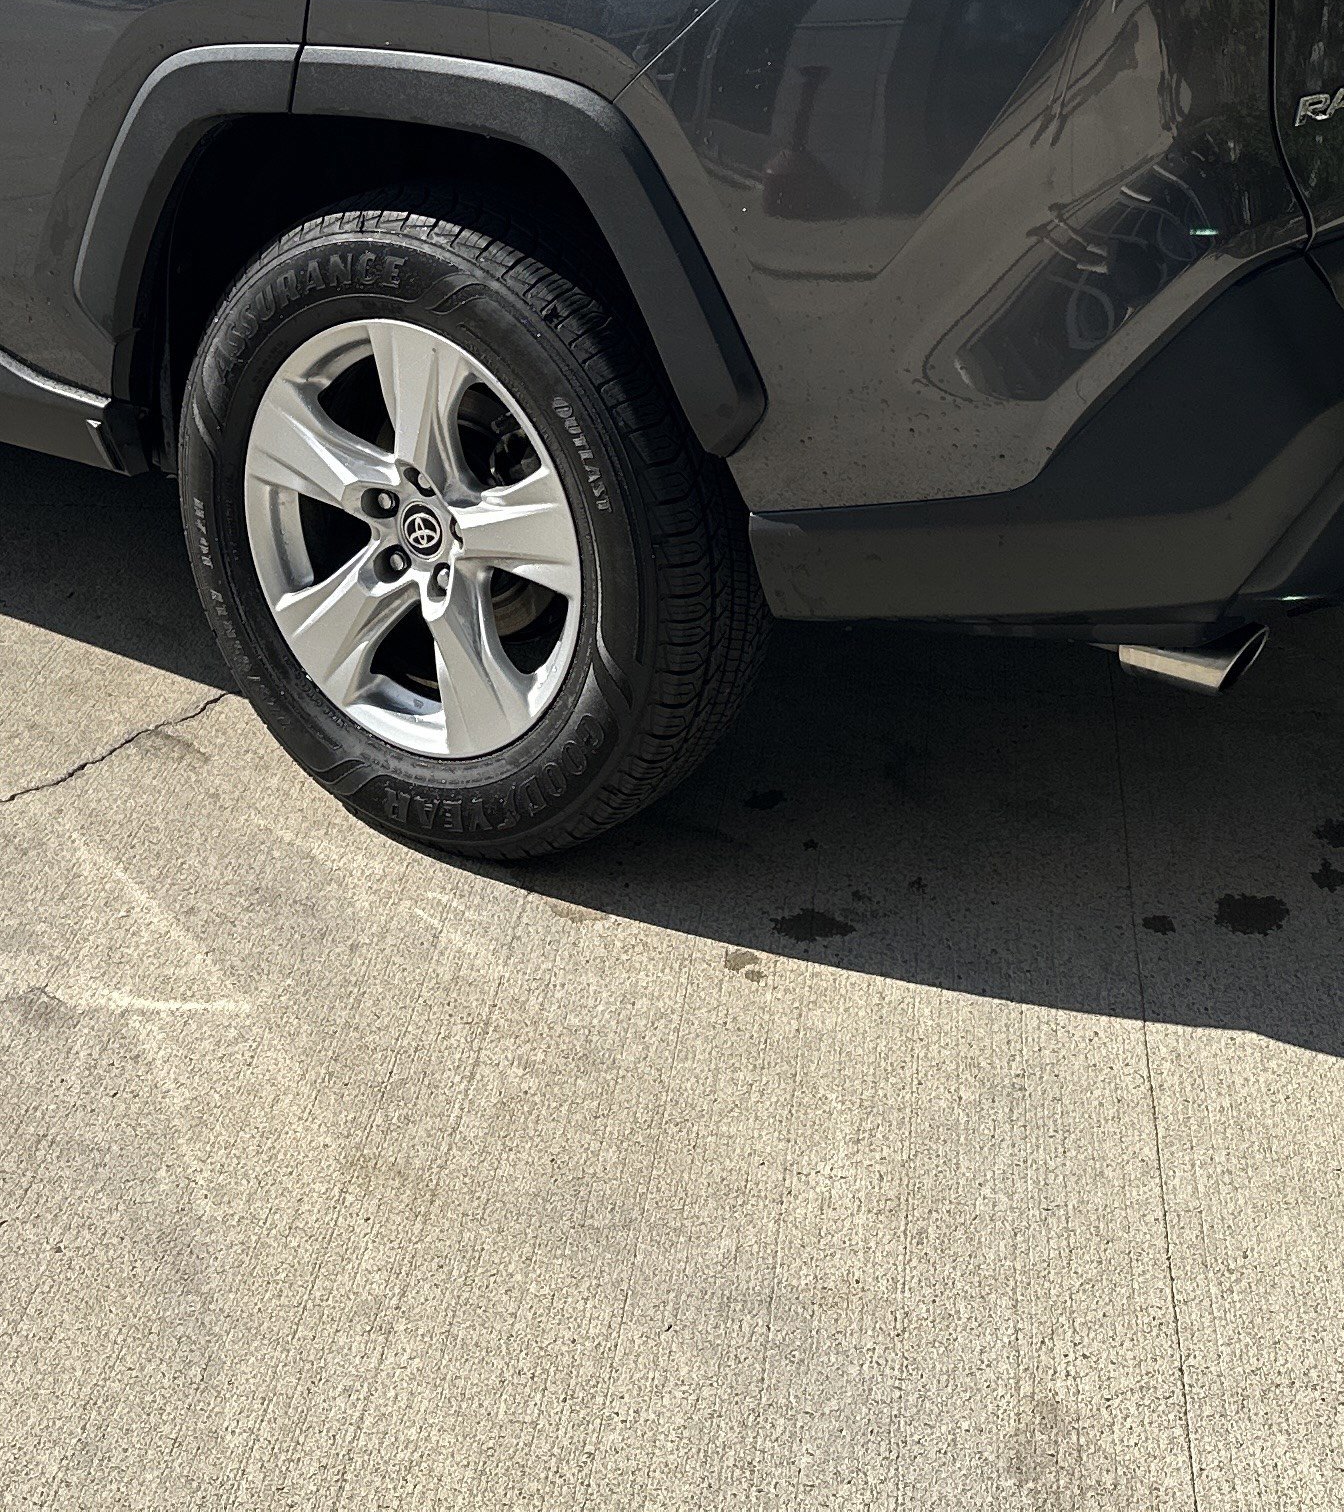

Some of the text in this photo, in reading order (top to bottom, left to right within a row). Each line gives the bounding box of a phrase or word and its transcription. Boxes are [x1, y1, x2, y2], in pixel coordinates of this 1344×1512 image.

[213, 250, 408, 385] ASSURANCE
[552, 396, 613, 513] OUTLAST
[384, 713, 606, 833] GOODYEAR
